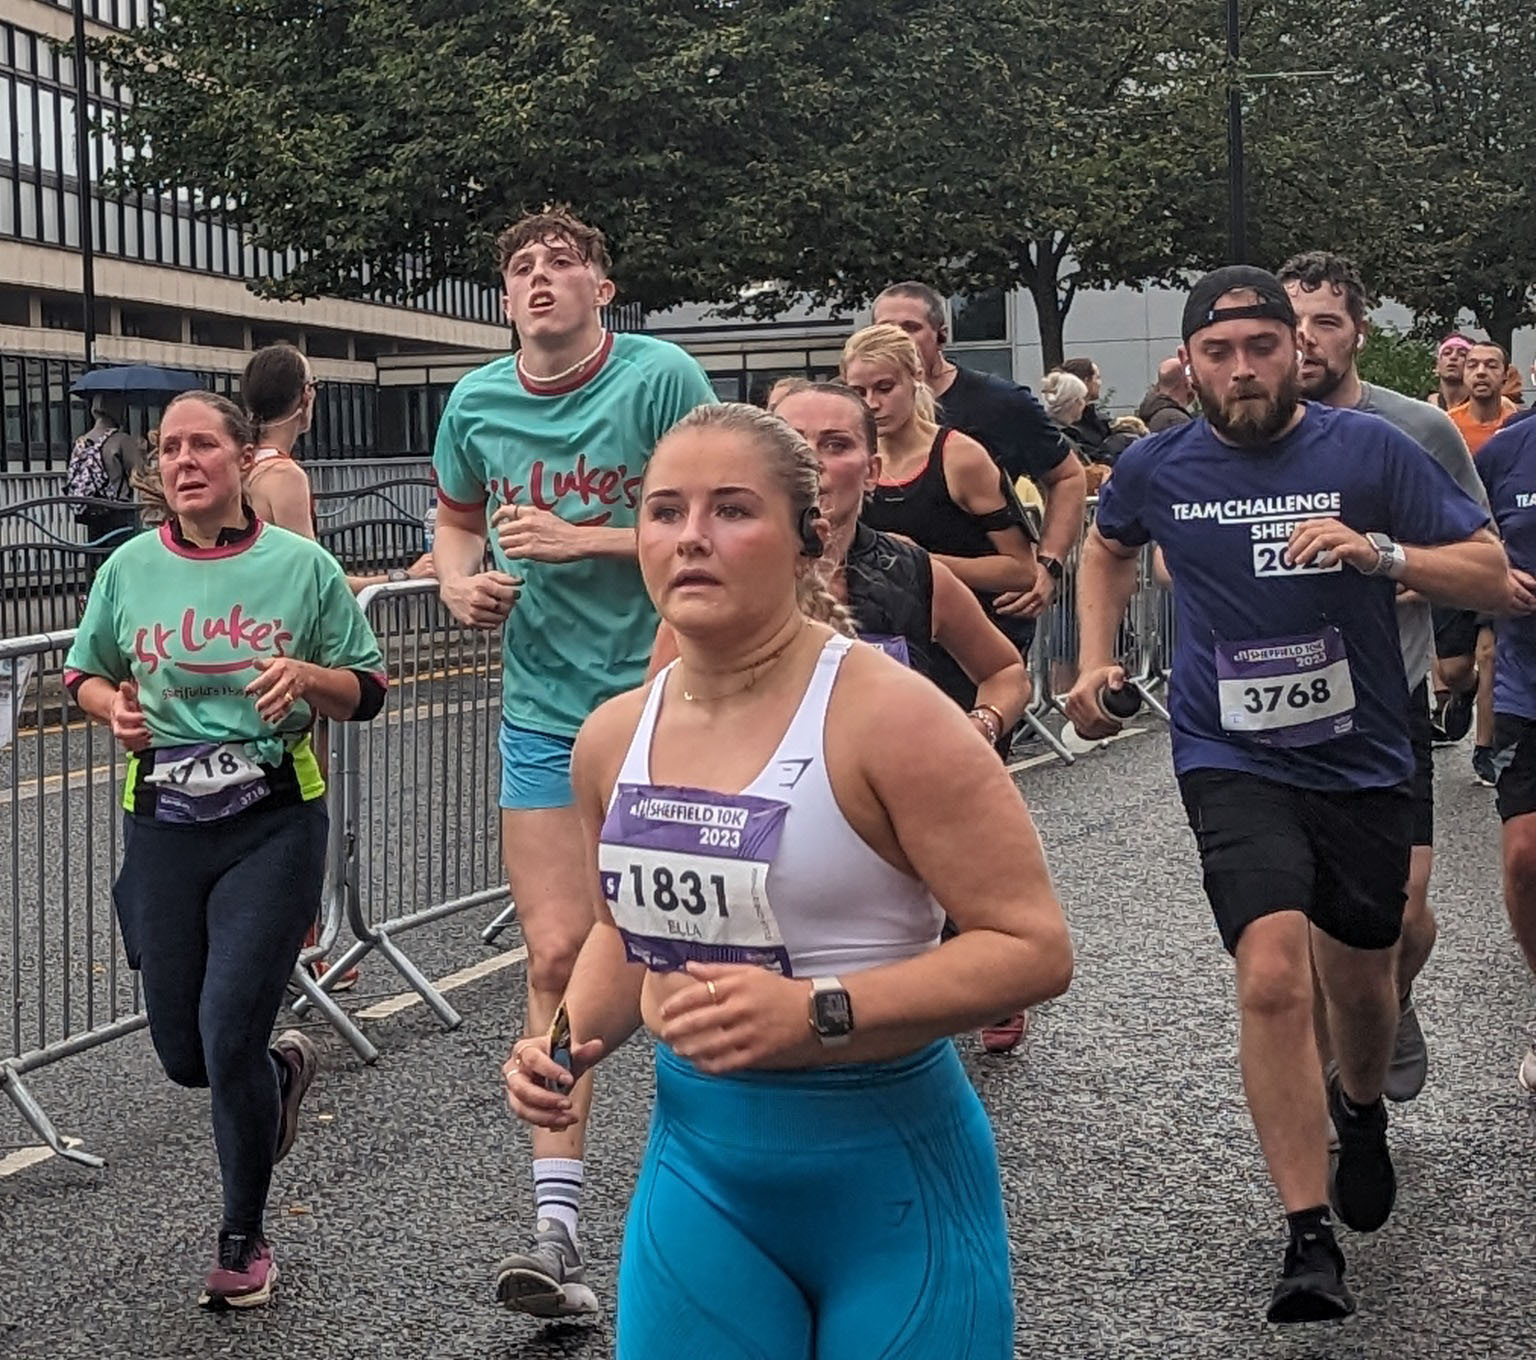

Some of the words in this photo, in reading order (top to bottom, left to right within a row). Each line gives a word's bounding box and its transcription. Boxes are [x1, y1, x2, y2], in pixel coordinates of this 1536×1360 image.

[530, 453, 642, 511] Luke's
[1251, 522, 1299, 540] SHEF
[181, 603, 294, 658] Luke's
[1244, 677, 1332, 714] 3768
[649, 801, 714, 822] SHEFFIELD
[717, 808, 745, 826] 10K
[699, 826, 742, 849] 2023
[629, 863, 730, 919] 1831
[667, 918, 703, 939] ELLA
